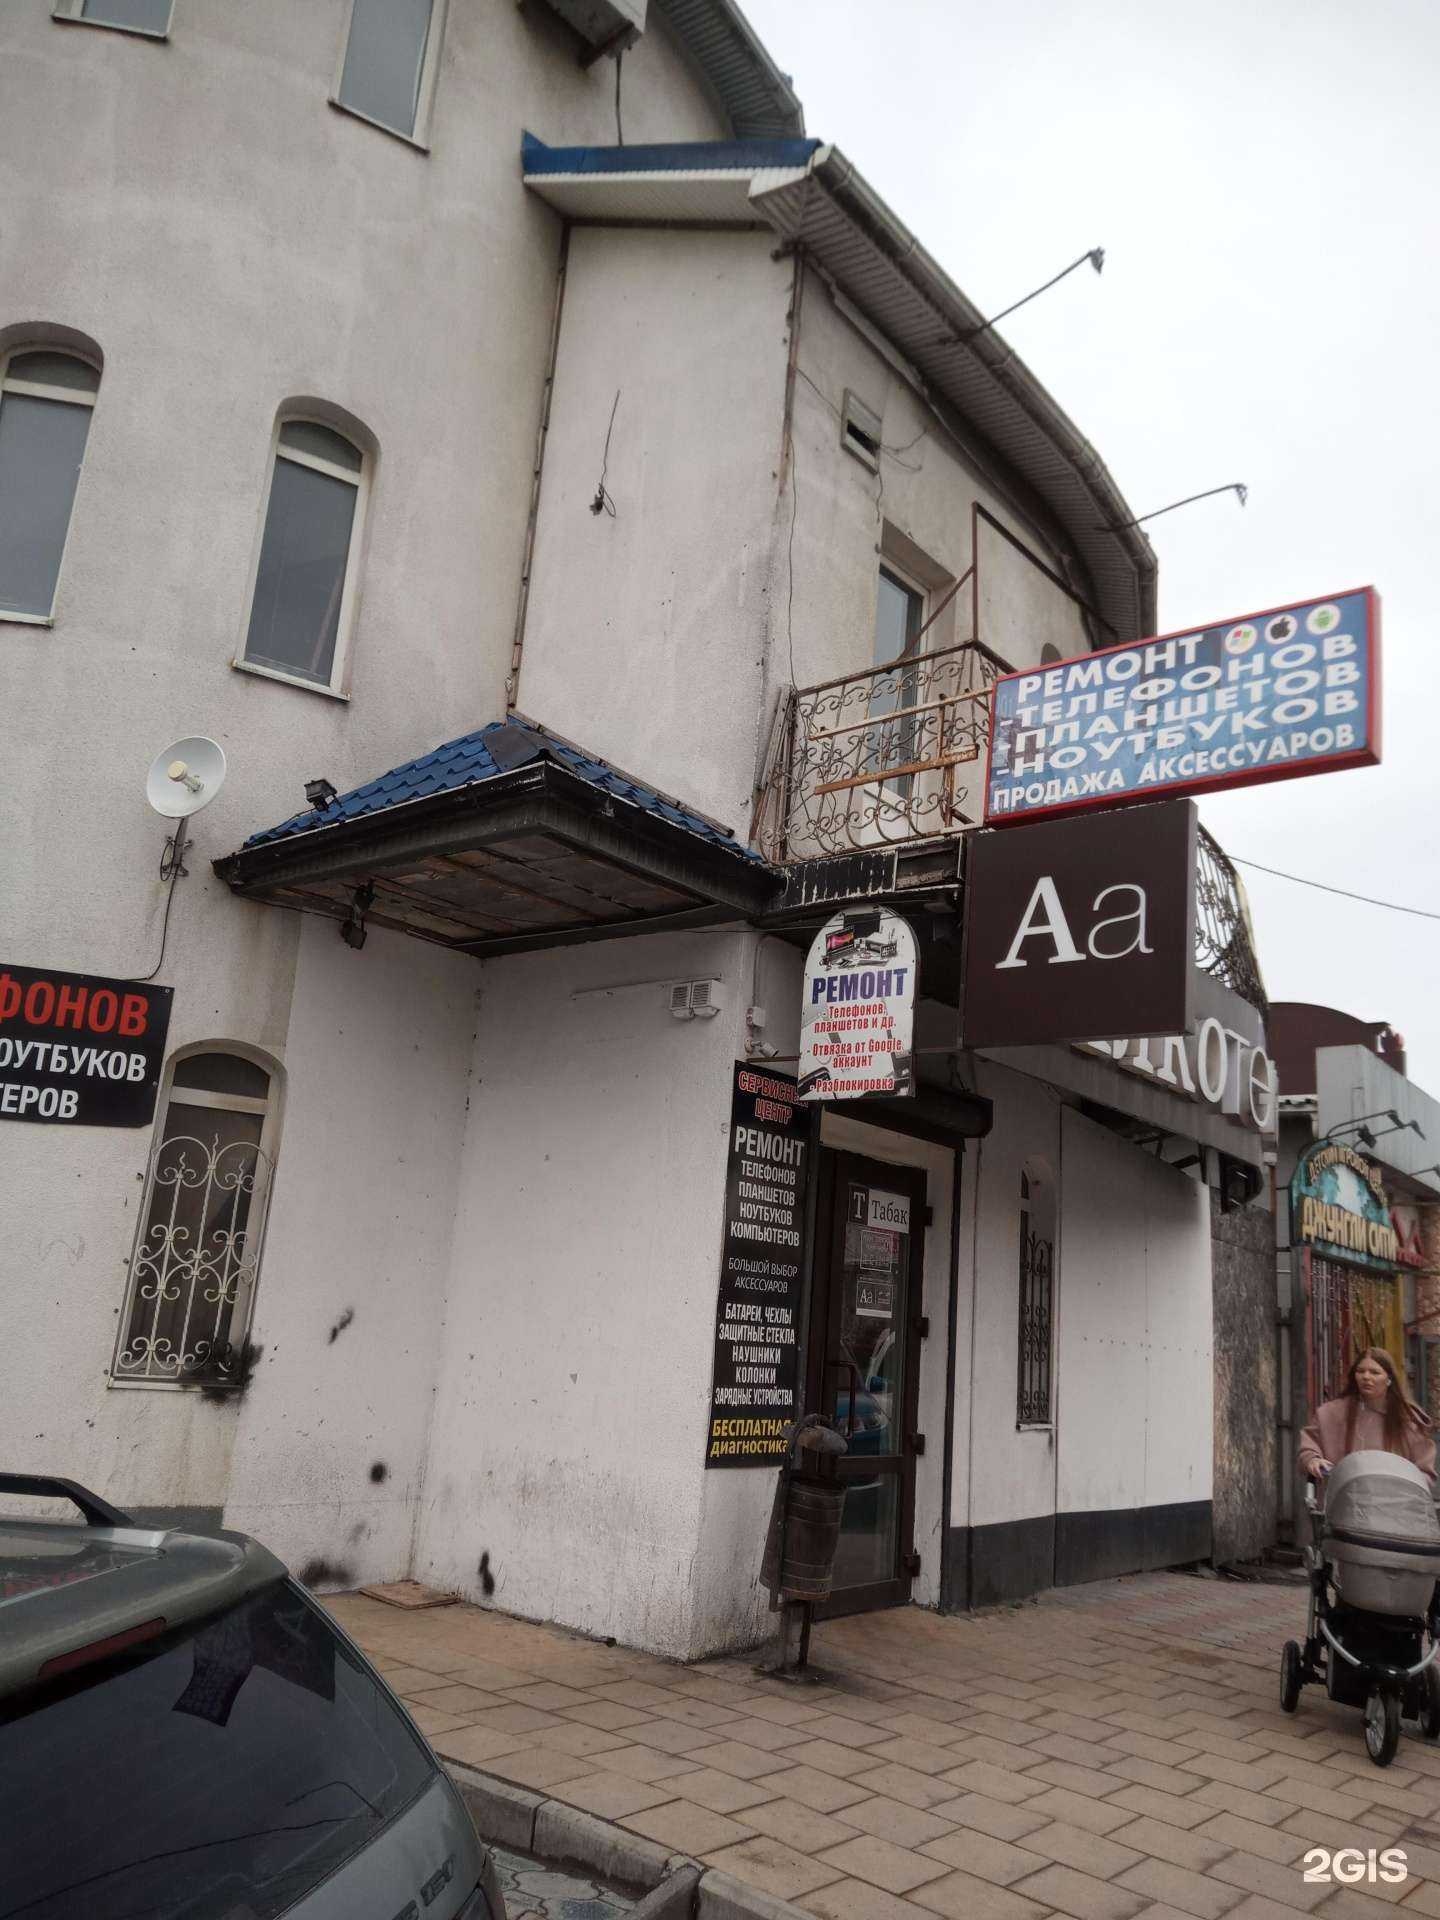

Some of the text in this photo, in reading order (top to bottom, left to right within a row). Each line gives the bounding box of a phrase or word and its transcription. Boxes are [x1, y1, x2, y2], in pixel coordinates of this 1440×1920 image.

[1018, 635, 1203, 703] РЕМОНТ
[993, 724, 1355, 810] ПРОДАЖА АКСЕССУАРОВ
[995, 876, 1154, 969] Аа
[812, 968, 908, 1004] РЕМОНТ
[814, 1016, 896, 1033] планшетов и др.
[813, 1043, 852, 1056] Отвязка
[855, 1042, 865, 1053] от
[833, 1055, 873, 1068] аккаунт
[0, 1082, 79, 1119] ЕРОВ
[754, 1098, 793, 1124] ЦЕНТР
[735, 1125, 805, 1166] РЕМОНТ
[741, 1160, 796, 1185] ТЕЛЕФОНОВ
[738, 1181, 795, 1207] ПЛАНШЕТОВ
[739, 1202, 793, 1226] НОУТБУКОВ
[872, 1200, 908, 1225] Табак
[1303, 1196, 1367, 1253] ДЖУНГЛИ
[730, 1221, 800, 1247] КОМПЬЮТЕРОВ
[728, 1256, 798, 1277] БОЛЬШОЙ ВЫБОР
[734, 1276, 788, 1293] АКСЕССУАРОВ
[765, 1306, 792, 1325] ЧЕХЛЫ
[719, 1323, 795, 1344] ЗАЩИТНЫЕ СТЕКЛА
[732, 1345, 781, 1364] НАУШНИКИ
[735, 1366, 776, 1384] КОЛОНКИ
[715, 1387, 793, 1406] ЗАРЯДНЫЕ УСТРОЙСТВА
